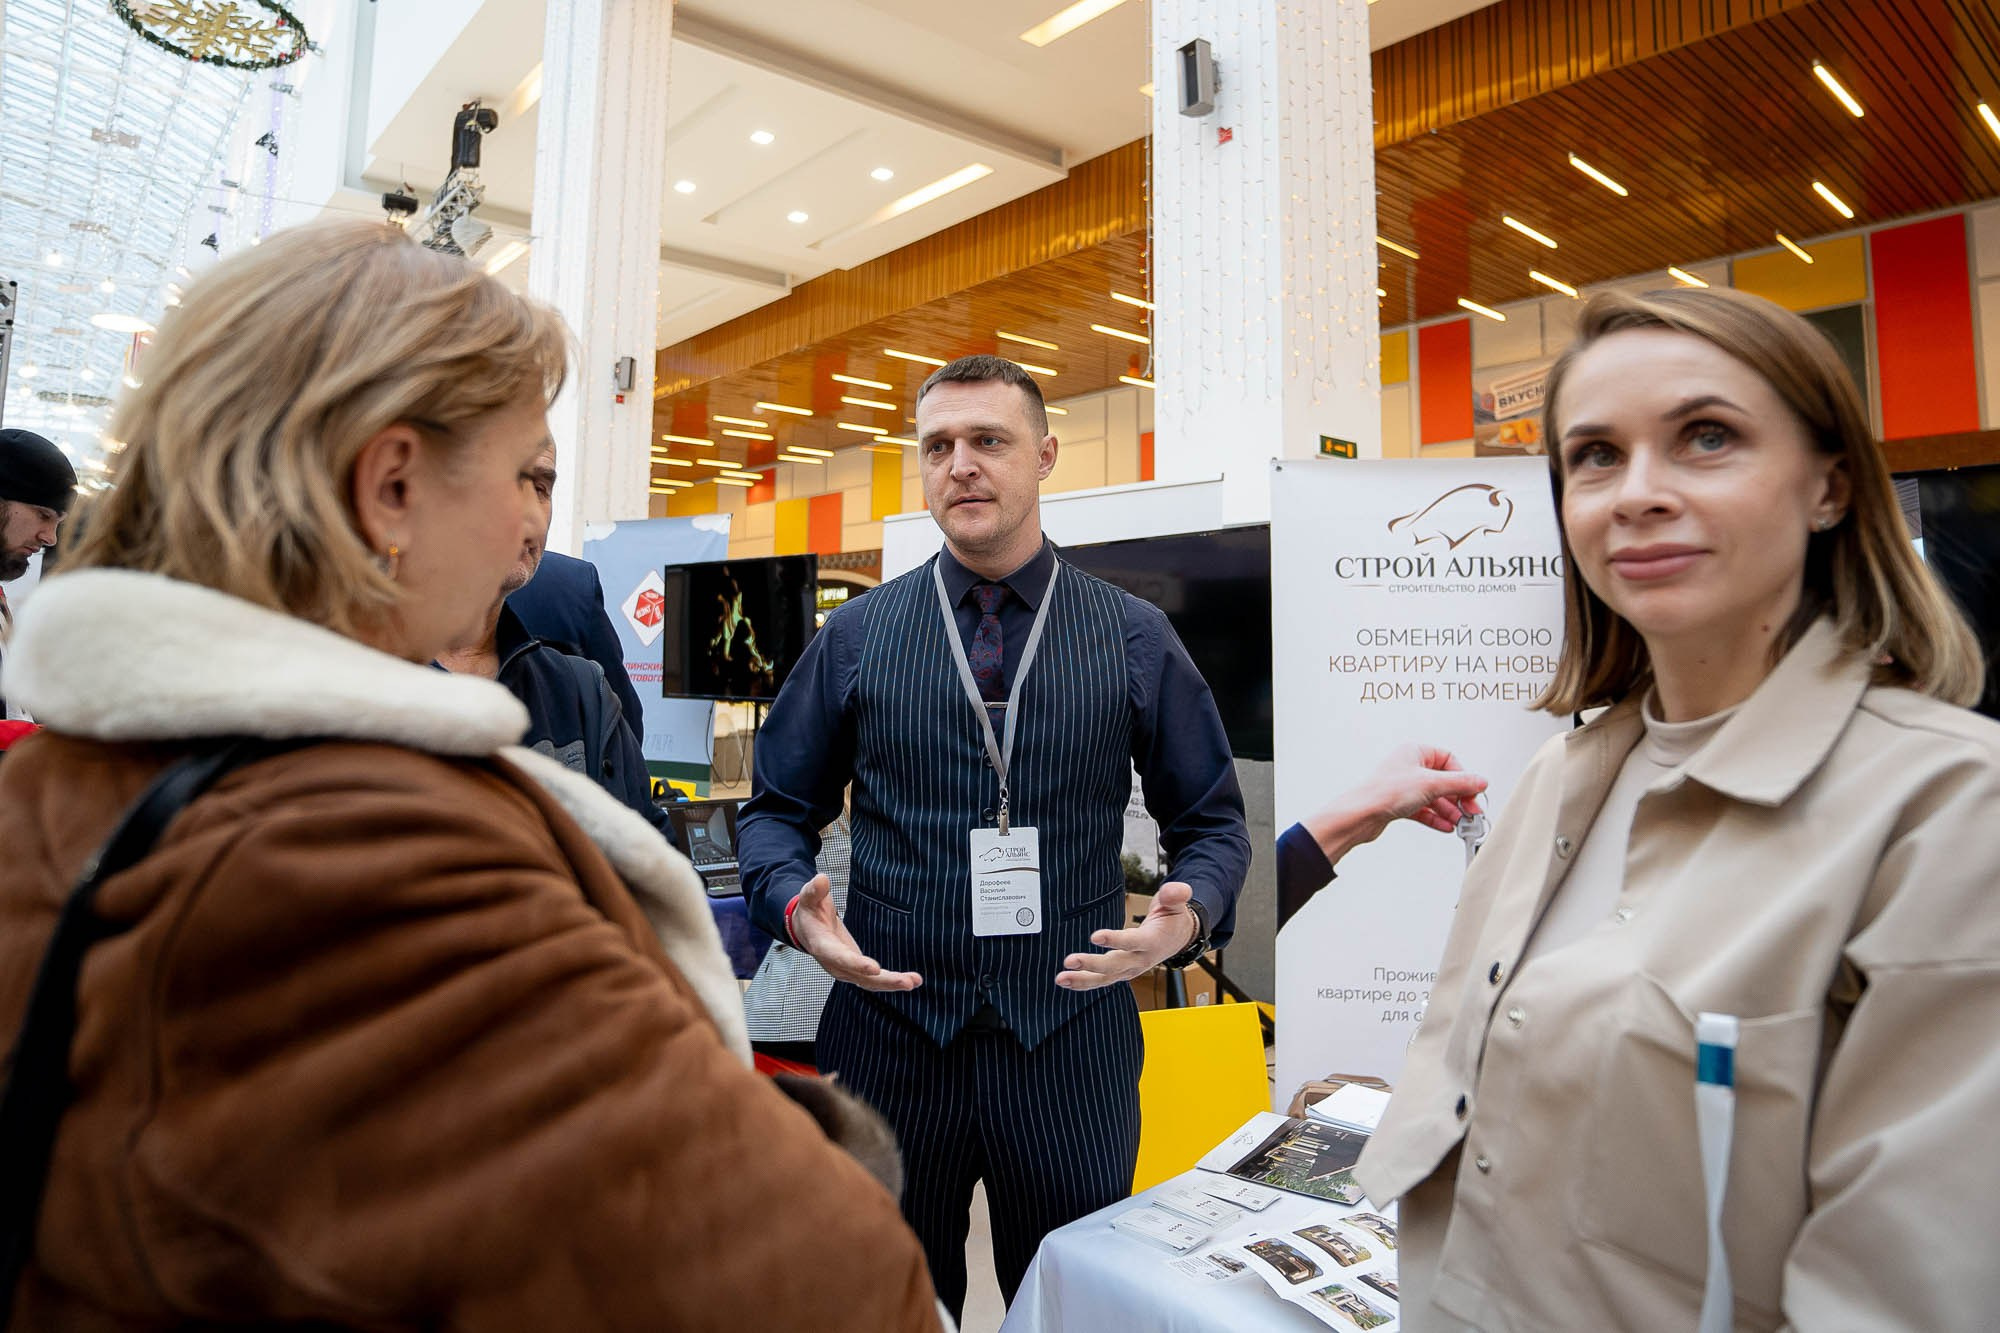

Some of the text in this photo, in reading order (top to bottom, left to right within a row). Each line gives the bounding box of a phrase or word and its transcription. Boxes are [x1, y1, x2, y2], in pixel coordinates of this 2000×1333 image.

[1498, 385, 1545, 408] ВКУСН
[1335, 553, 1435, 579] СТРОЙ
[1388, 583, 1517, 594] СТРОИТЕЛЬСТВО ДОМОВ
[1356, 624, 1553, 647] ОБМЕНЯЙ СВОЮ
[1329, 655, 1448, 673] КВАРТИРУ
[1456, 655, 1488, 673] НА
[1360, 681, 1548, 704] ДОМ В ТЮМЕНИ
[1373, 967, 1437, 984] Прожив
[1317, 987, 1392, 1003] квартире
[1396, 991, 1417, 1004] до
[1381, 1010, 1409, 1024] для
